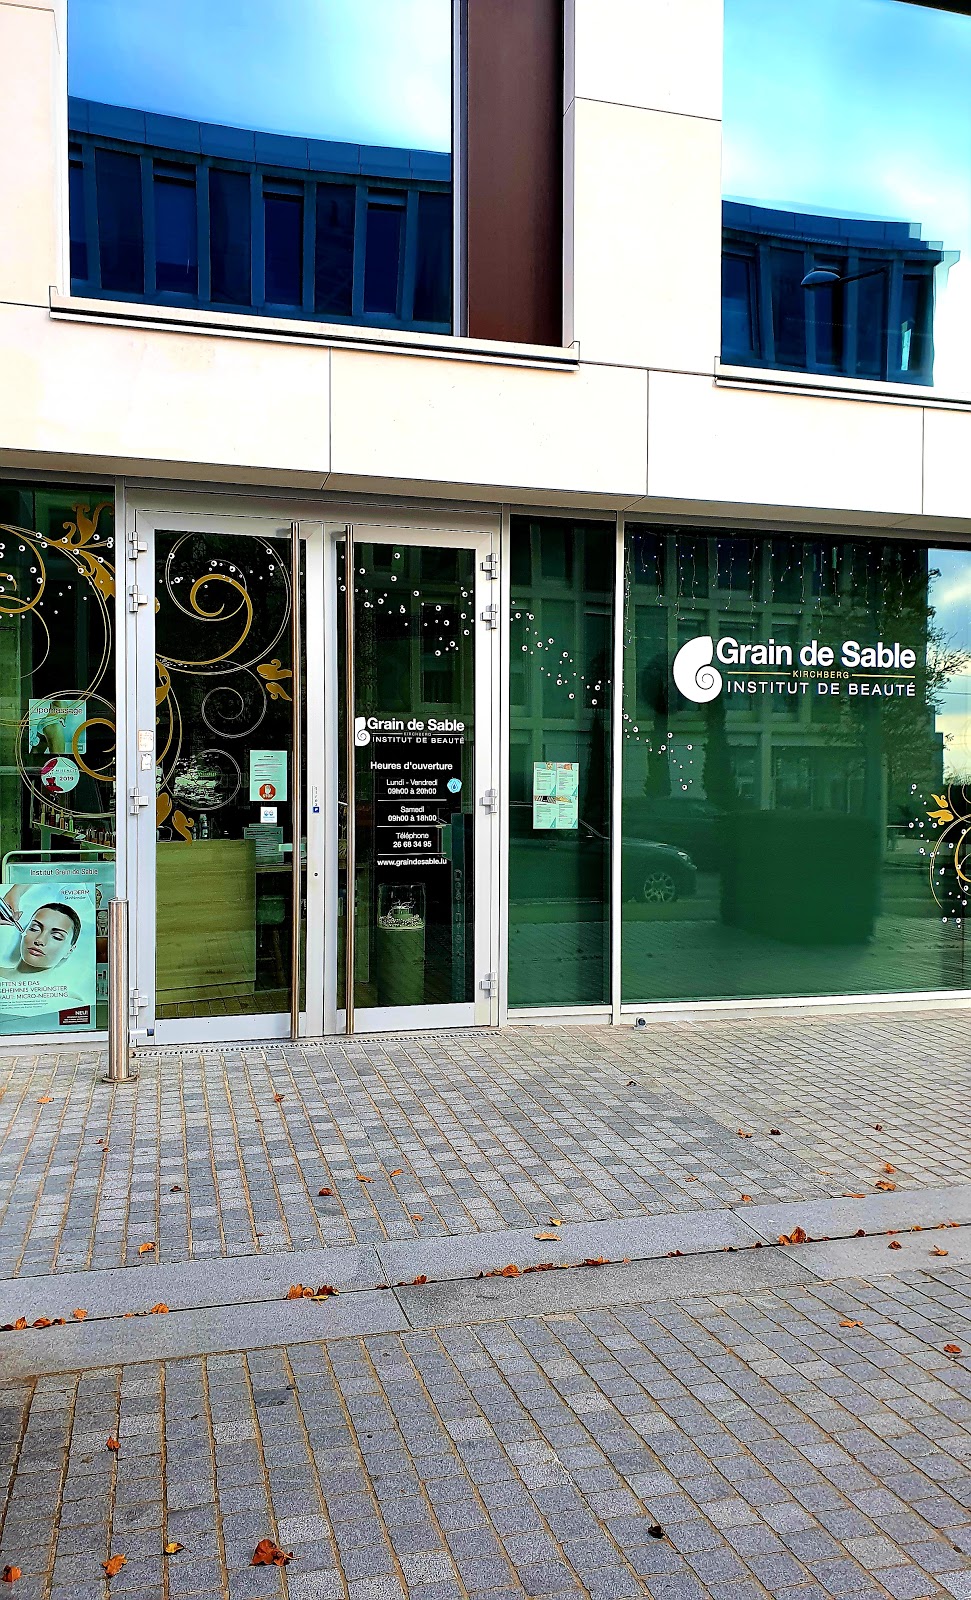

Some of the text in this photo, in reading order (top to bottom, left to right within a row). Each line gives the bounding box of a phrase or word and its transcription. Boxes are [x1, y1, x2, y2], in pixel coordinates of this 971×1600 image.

[716, 636, 916, 669] Grain de Sable
[792, 670, 849, 679] KIRCHBERG
[727, 680, 916, 697] INSTITUT DE BEAUTÉ
[367, 717, 465, 732] Grain de Sable
[370, 761, 453, 770] Heures d'ouverture
[395, 832, 429, 840] Téléphone
[377, 858, 447, 867] www.graindesable.lu
